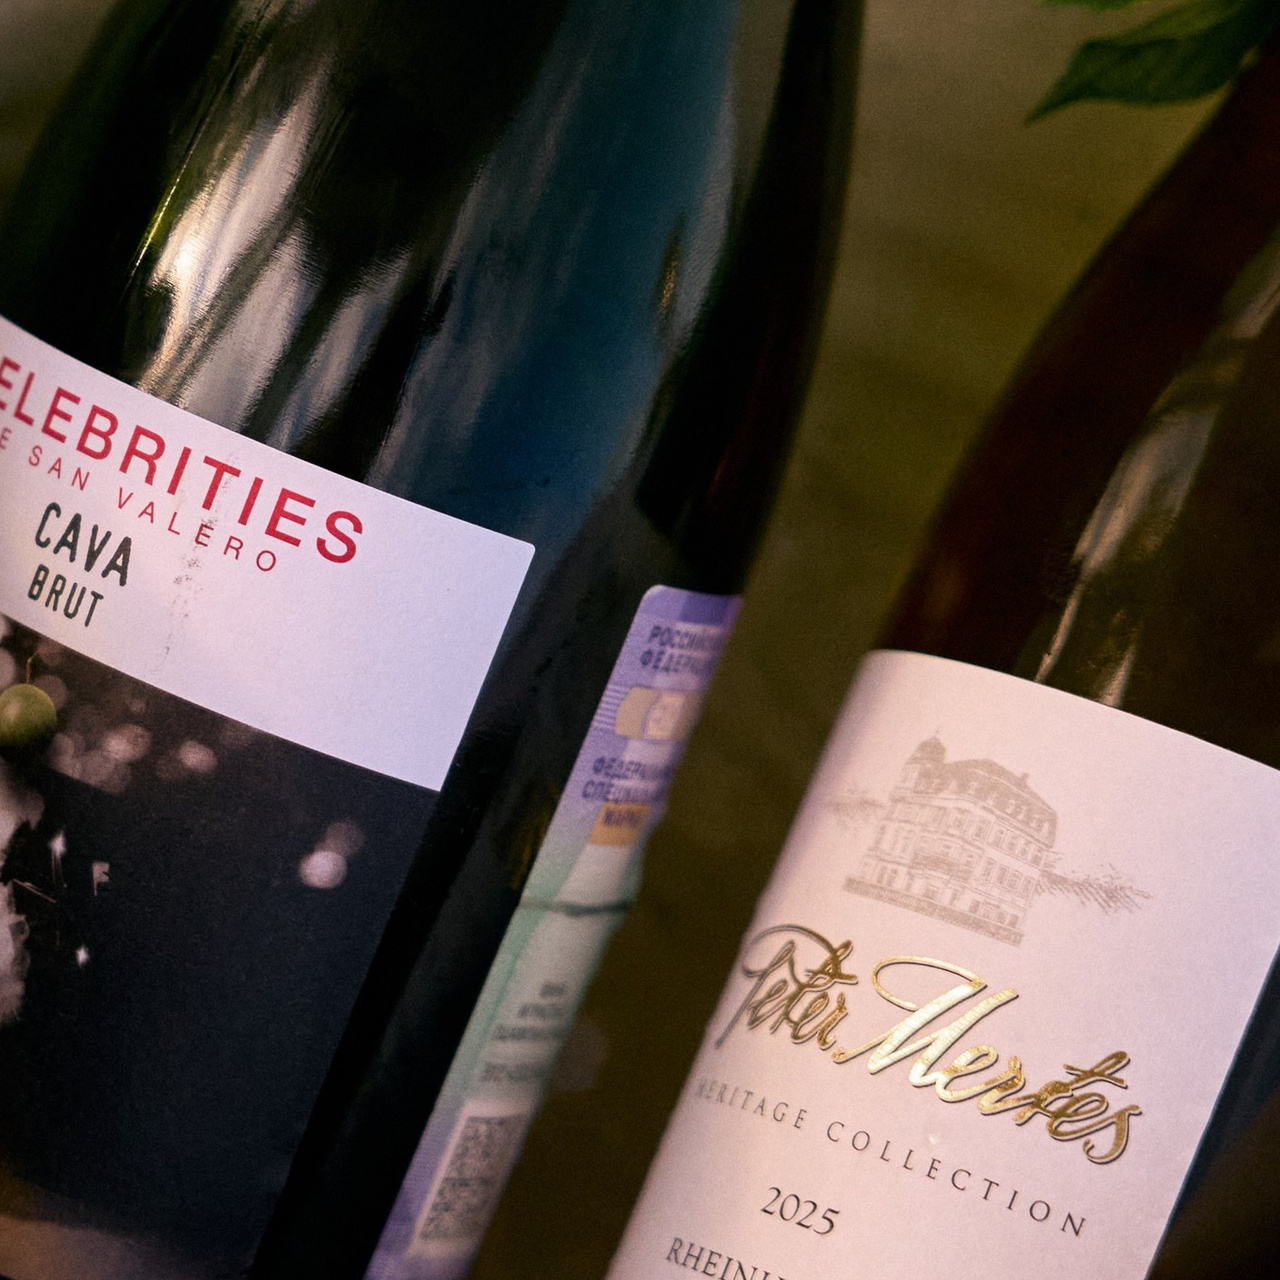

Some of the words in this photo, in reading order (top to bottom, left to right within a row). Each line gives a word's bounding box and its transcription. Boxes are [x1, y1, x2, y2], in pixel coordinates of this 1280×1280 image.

[28, 445, 90, 491] SAN
[117, 486, 278, 573] VALERO
[34, 502, 132, 587] CAVA
[27, 564, 105, 627] BRUT
[715, 923, 859, 1051] Peter
[831, 953, 1142, 1166] Mertes
[695, 1077, 807, 1129] HERITAGE
[826, 1121, 1086, 1237] COLLECTION
[760, 1186, 841, 1236] 2025
